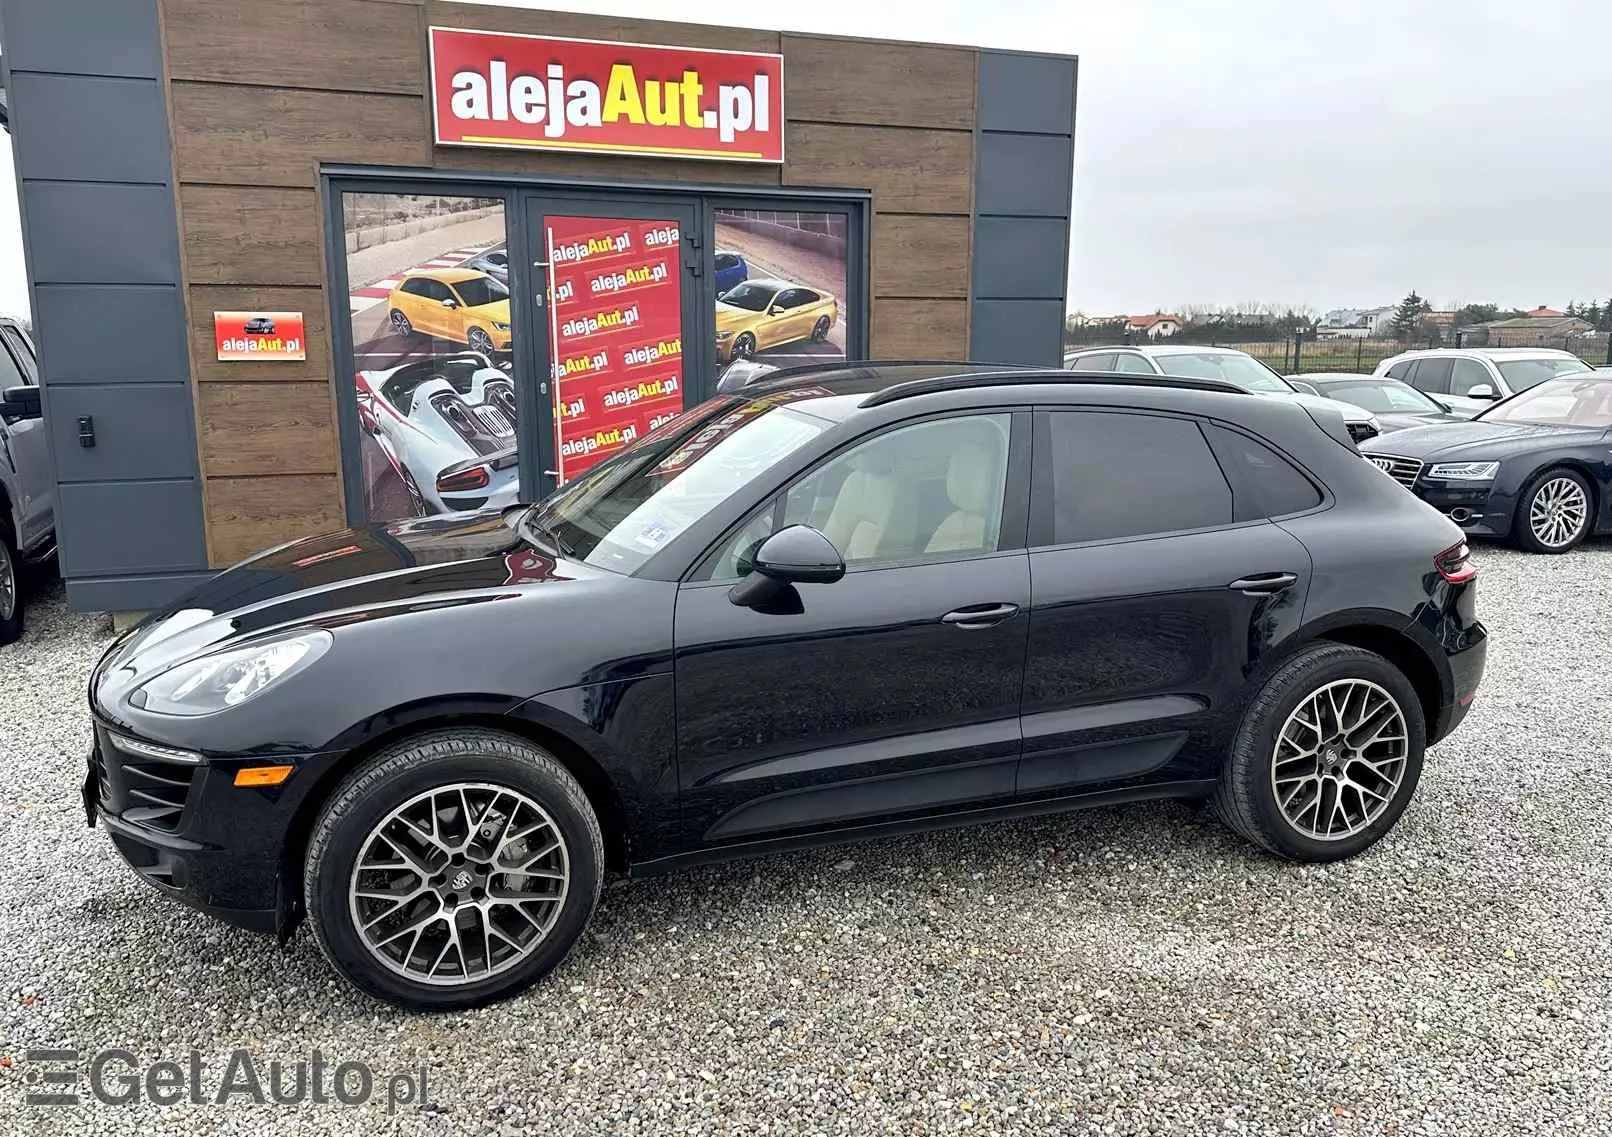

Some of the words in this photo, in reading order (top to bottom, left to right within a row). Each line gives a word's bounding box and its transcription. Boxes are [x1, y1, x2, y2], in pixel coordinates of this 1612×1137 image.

[451, 60, 769, 143] alejaAut.pl
[552, 232, 631, 262] alejaAut.pl
[590, 262, 668, 292] alejaAut.pl
[562, 304, 640, 337] alejaAut.pl
[222, 337, 300, 353] alejaAut.pl
[603, 375, 679, 407] alejaAut.pl
[561, 424, 638, 456] alejaAut.pl
